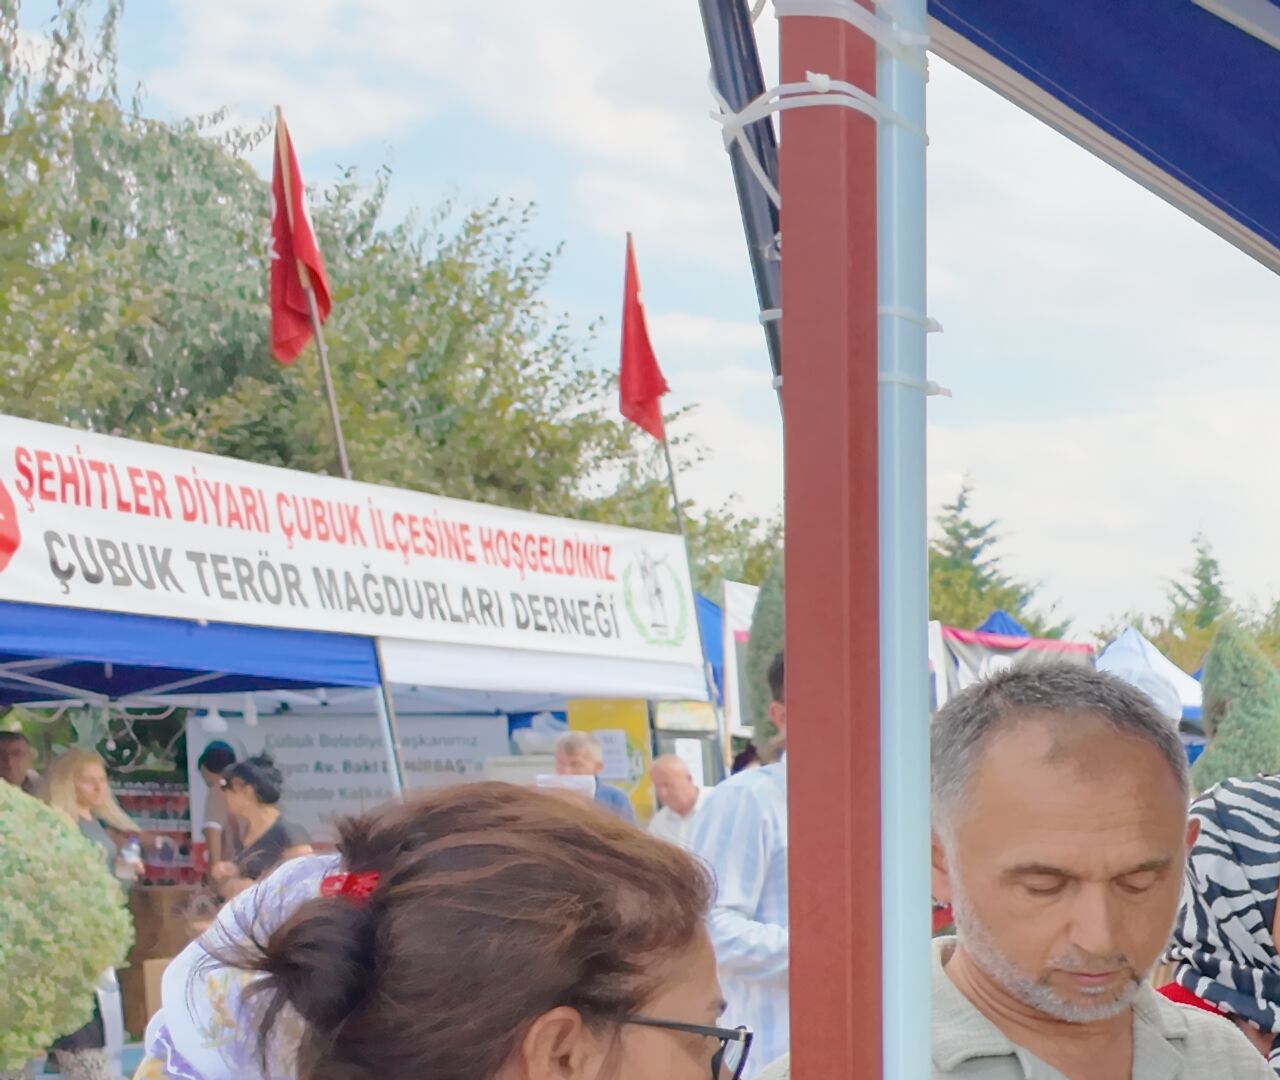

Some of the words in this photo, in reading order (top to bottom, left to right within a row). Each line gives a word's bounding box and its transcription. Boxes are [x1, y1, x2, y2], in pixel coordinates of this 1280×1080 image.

[14, 445, 172, 520] ŞEHİTLER
[174, 466, 271, 534] DİYARI
[275, 491, 368, 549] ÇUBUK
[368, 497, 477, 565] İLÇESİNE
[478, 524, 617, 581] HOŞGELDİNİZ
[43, 530, 187, 594] ÇUBUK
[186, 550, 309, 608] TERÖR
[312, 562, 506, 629] MAĞDURLARI
[509, 592, 621, 640] DERNEĞİ
